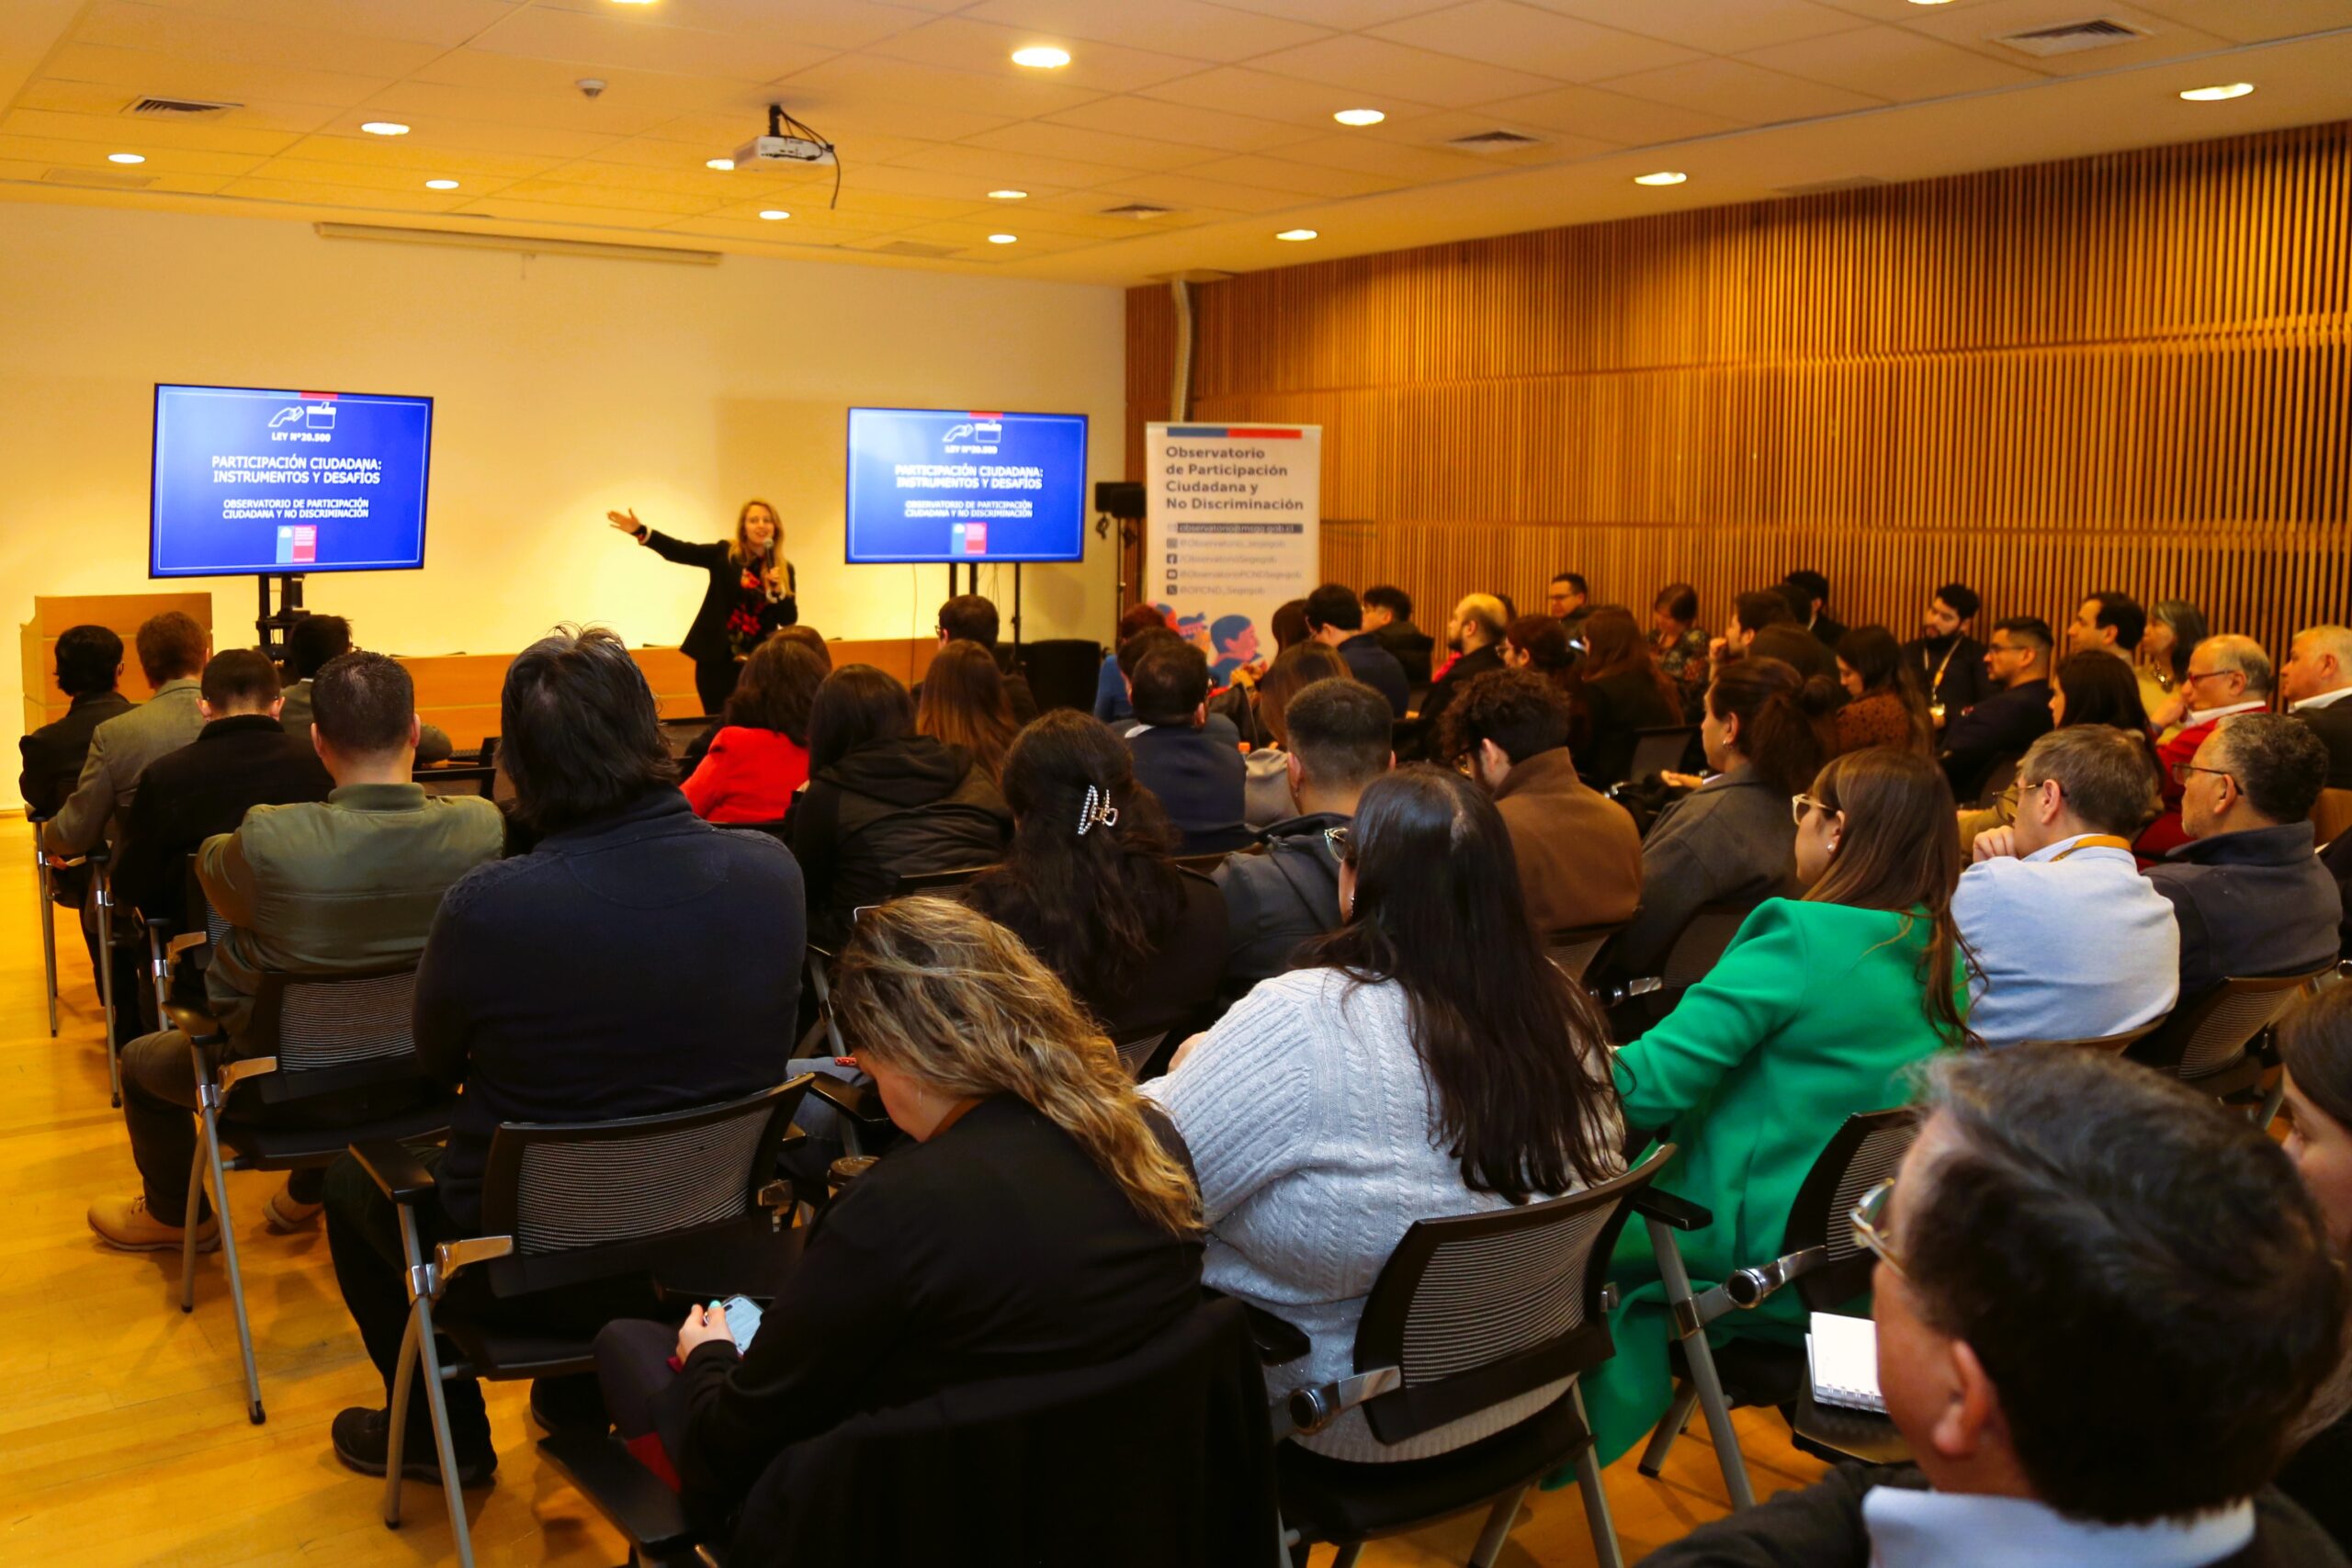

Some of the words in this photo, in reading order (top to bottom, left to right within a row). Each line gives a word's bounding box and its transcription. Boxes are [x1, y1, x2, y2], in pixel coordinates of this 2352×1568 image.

[272, 432, 288, 441] LEY
[1166, 446, 1264, 458] Observatorio
[212, 454, 307, 469] PARTICIPACIÓN
[311, 457, 381, 470] CIUDADANA:
[213, 470, 309, 483] INSTRUMENTOS
[312, 471, 321, 483] Y
[323, 468, 380, 484] DESAFÍOS
[895, 463, 977, 476] PARTICIPACIÓN
[979, 466, 1043, 478] CIUDADANA:
[1167, 465, 1183, 475] de
[1189, 465, 1287, 477] Participación
[896, 478, 978, 489] INSTRUMENTOS
[982, 478, 989, 488] Y
[991, 475, 1042, 489] DESAFÍOS
[1166, 481, 1246, 492] Ciudadana
[1250, 484, 1259, 494] y
[223, 499, 290, 508] OBSERVATORIO
[293, 499, 304, 508] DE
[307, 497, 368, 509] PARTICIPACIÓN
[905, 501, 965, 509] OBSERVATORIO
[978, 500, 1032, 509] PARTICIPACIÓN
[1167, 498, 1186, 509] No
[1192, 498, 1303, 510] Discriminación
[222, 509, 274, 519] CIUDADANA
[277, 509, 283, 518] Y
[284, 509, 297, 518] NO
[300, 507, 368, 518] DISCRIMINACIÓN
[905, 509, 950, 517] CIUDADANA
[951, 509, 956, 517] Y
[958, 509, 969, 517] NO
[971, 508, 1033, 517] DISCRIMINACIÓN
